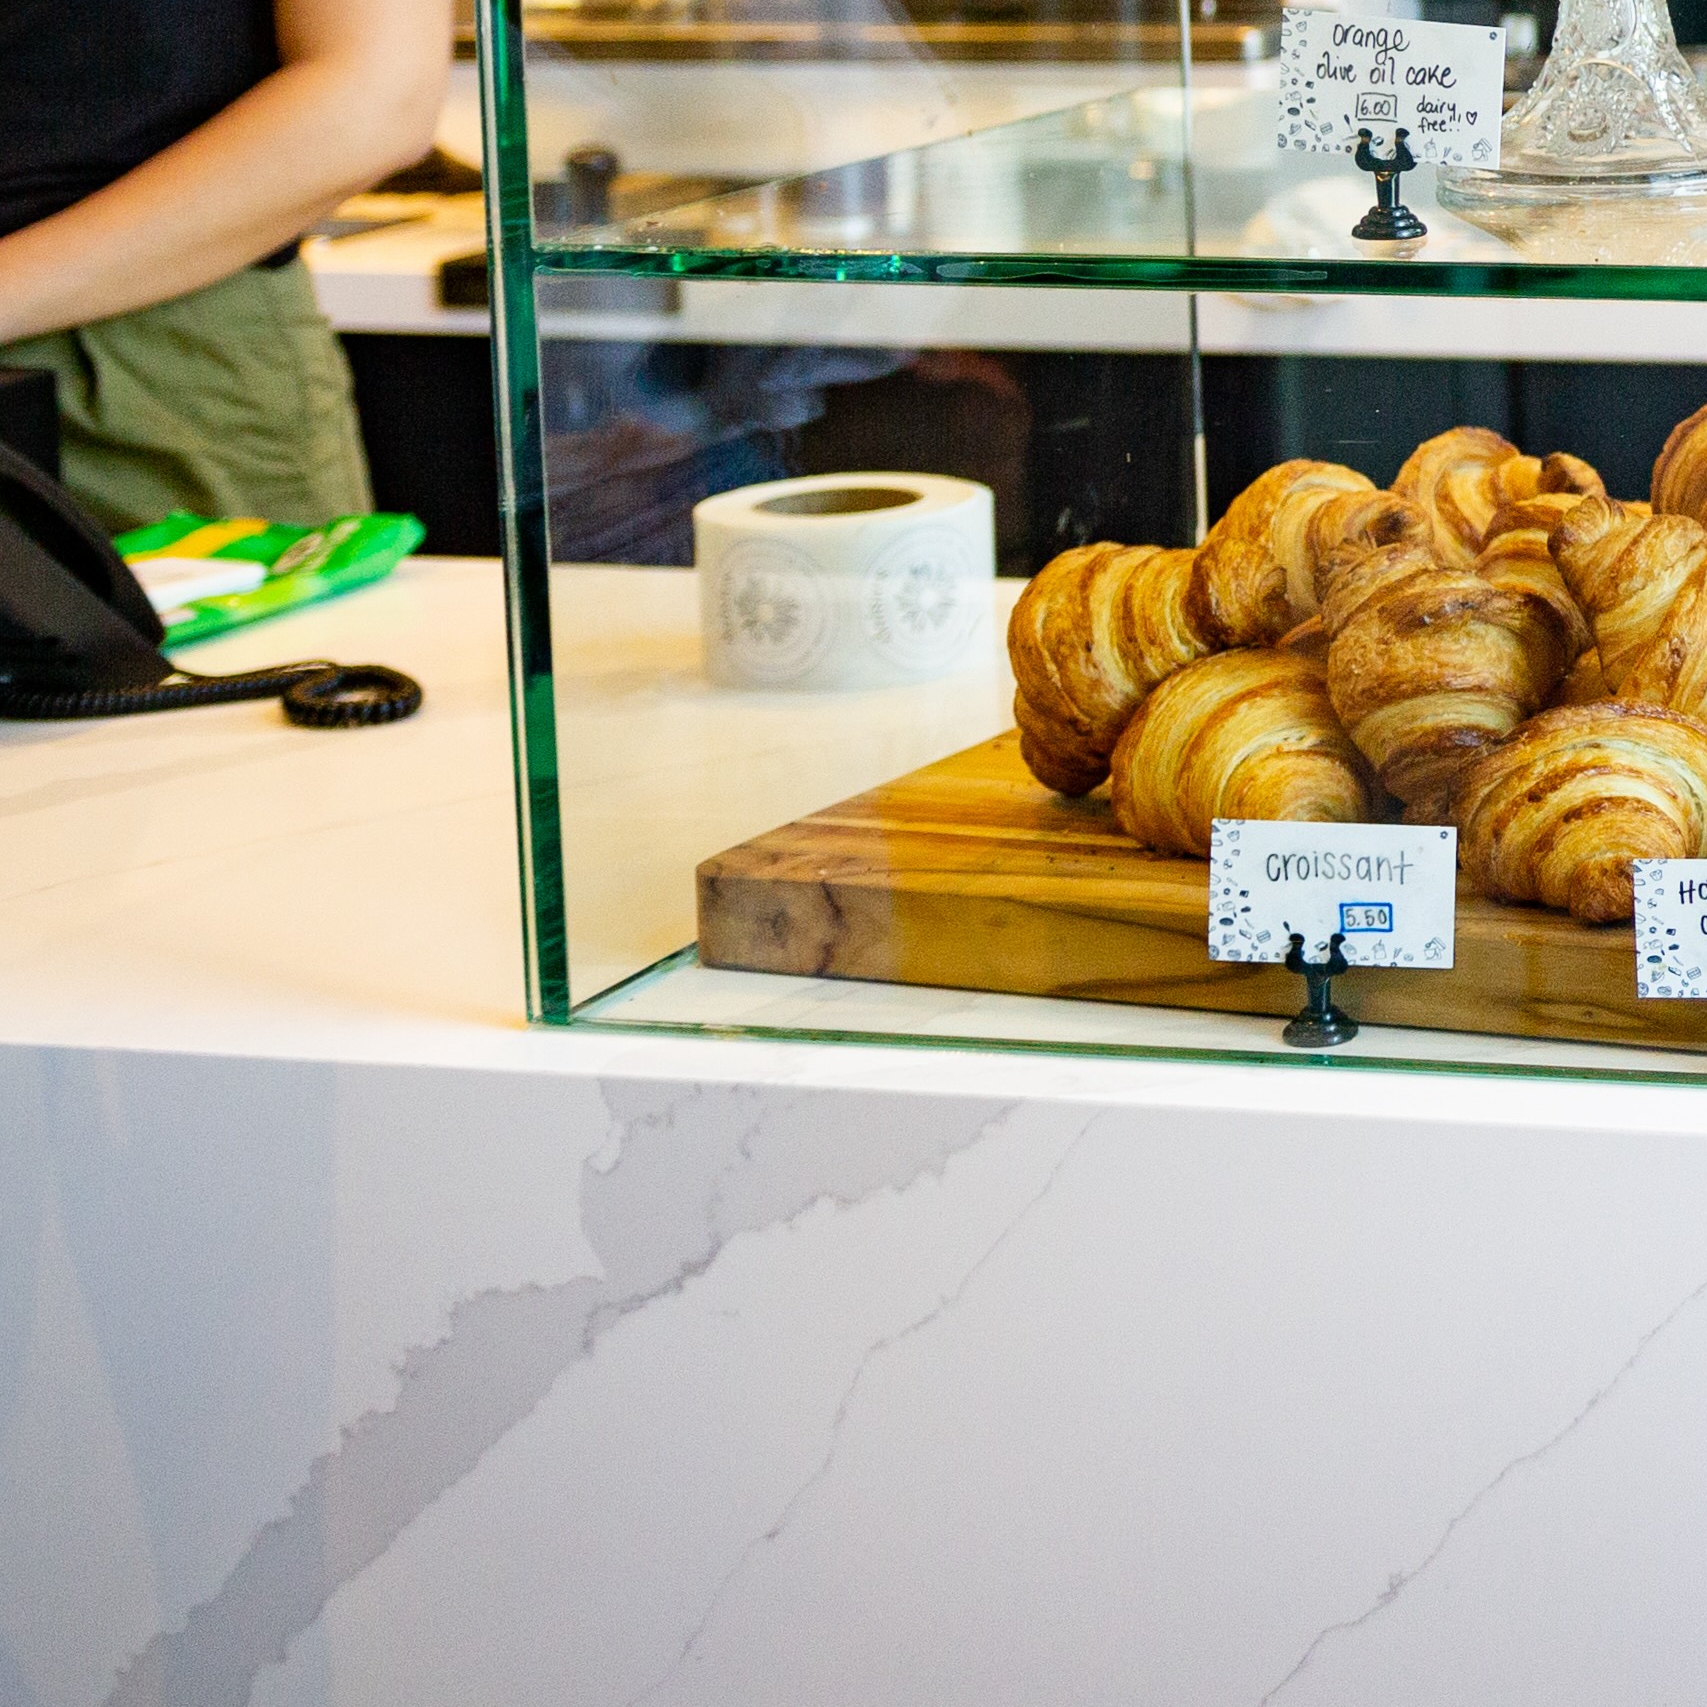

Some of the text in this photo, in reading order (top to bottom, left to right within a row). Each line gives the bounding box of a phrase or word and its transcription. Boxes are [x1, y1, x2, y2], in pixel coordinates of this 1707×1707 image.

[1333, 23, 1410, 65] orange
[1316, 51, 1457, 89] olive oil cake
[1360, 99, 1391, 117] 6.00
[1416, 94, 1457, 121] dairy
[1345, 908, 1388, 928] 5.50
